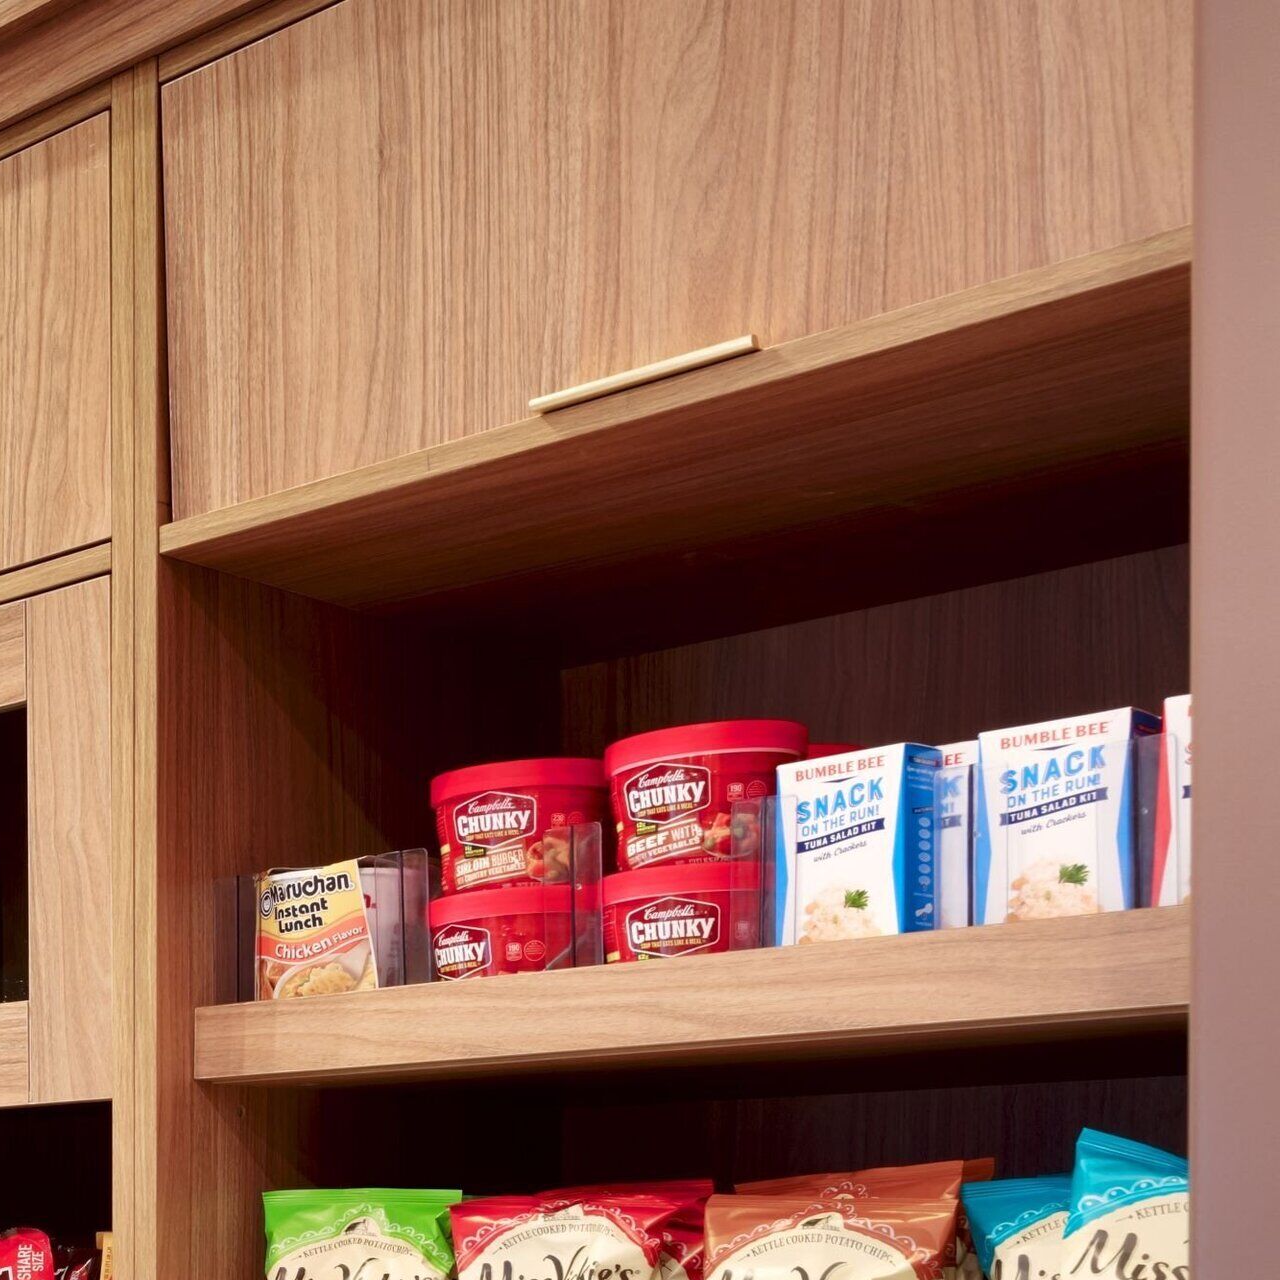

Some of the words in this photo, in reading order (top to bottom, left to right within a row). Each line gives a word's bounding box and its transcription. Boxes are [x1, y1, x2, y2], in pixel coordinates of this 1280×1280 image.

[1000, 727, 1071, 750] BUMBLE
[1076, 721, 1109, 738] BEE
[795, 760, 855, 782] BUMBLE
[857, 755, 886, 769] BEE
[999, 745, 1107, 793] SNACK
[628, 781, 705, 813] CHUNKY
[796, 777, 884, 824] SNACK
[1007, 794, 1025, 808] ON
[1032, 786, 1059, 803] THE
[1061, 773, 1100, 797] RUN!
[801, 822, 818, 837] ON
[822, 816, 846, 832] THE
[849, 805, 880, 824] RUN!
[1009, 808, 1038, 824] TUNA
[1040, 797, 1076, 817] SALAD
[1078, 791, 1097, 807] KIT
[457, 810, 530, 837] CHUNKY
[804, 837, 828, 850] TUNA
[829, 827, 858, 844] SALAD
[861, 821, 876, 835] KIT
[1020, 822, 1043, 835] with
[1045, 810, 1087, 831] Crackers
[628, 834, 667, 857] BEEF
[813, 850, 831, 863] with
[833, 840, 868, 858] Crackers
[270, 873, 351, 903] Maruchan
[274, 897, 329, 920] Instant
[278, 913, 323, 933] Lunch
[631, 917, 715, 945] CHUNKY
[275, 936, 332, 959] Chicken
[333, 927, 365, 944] Flavor
[435, 942, 485, 969] CHUNKY
[1137, 1202, 1182, 1220] KETTLE
[504, 1231, 532, 1250] KETTLE
[532, 1225, 567, 1237] COOKED
[1022, 1219, 1062, 1242] KETTLE
[303, 1243, 333, 1259] KETTLE
[333, 1238, 363, 1250] COOKED
[750, 1236, 785, 1259] KETTLE
[786, 1232, 824, 1247] COOKED
[825, 1233, 862, 1253] POTATO
[863, 1244, 894, 1262] CHIPS
[17, 1244, 33, 1280] SHARE
[32, 1250, 45, 1272] SIZE
